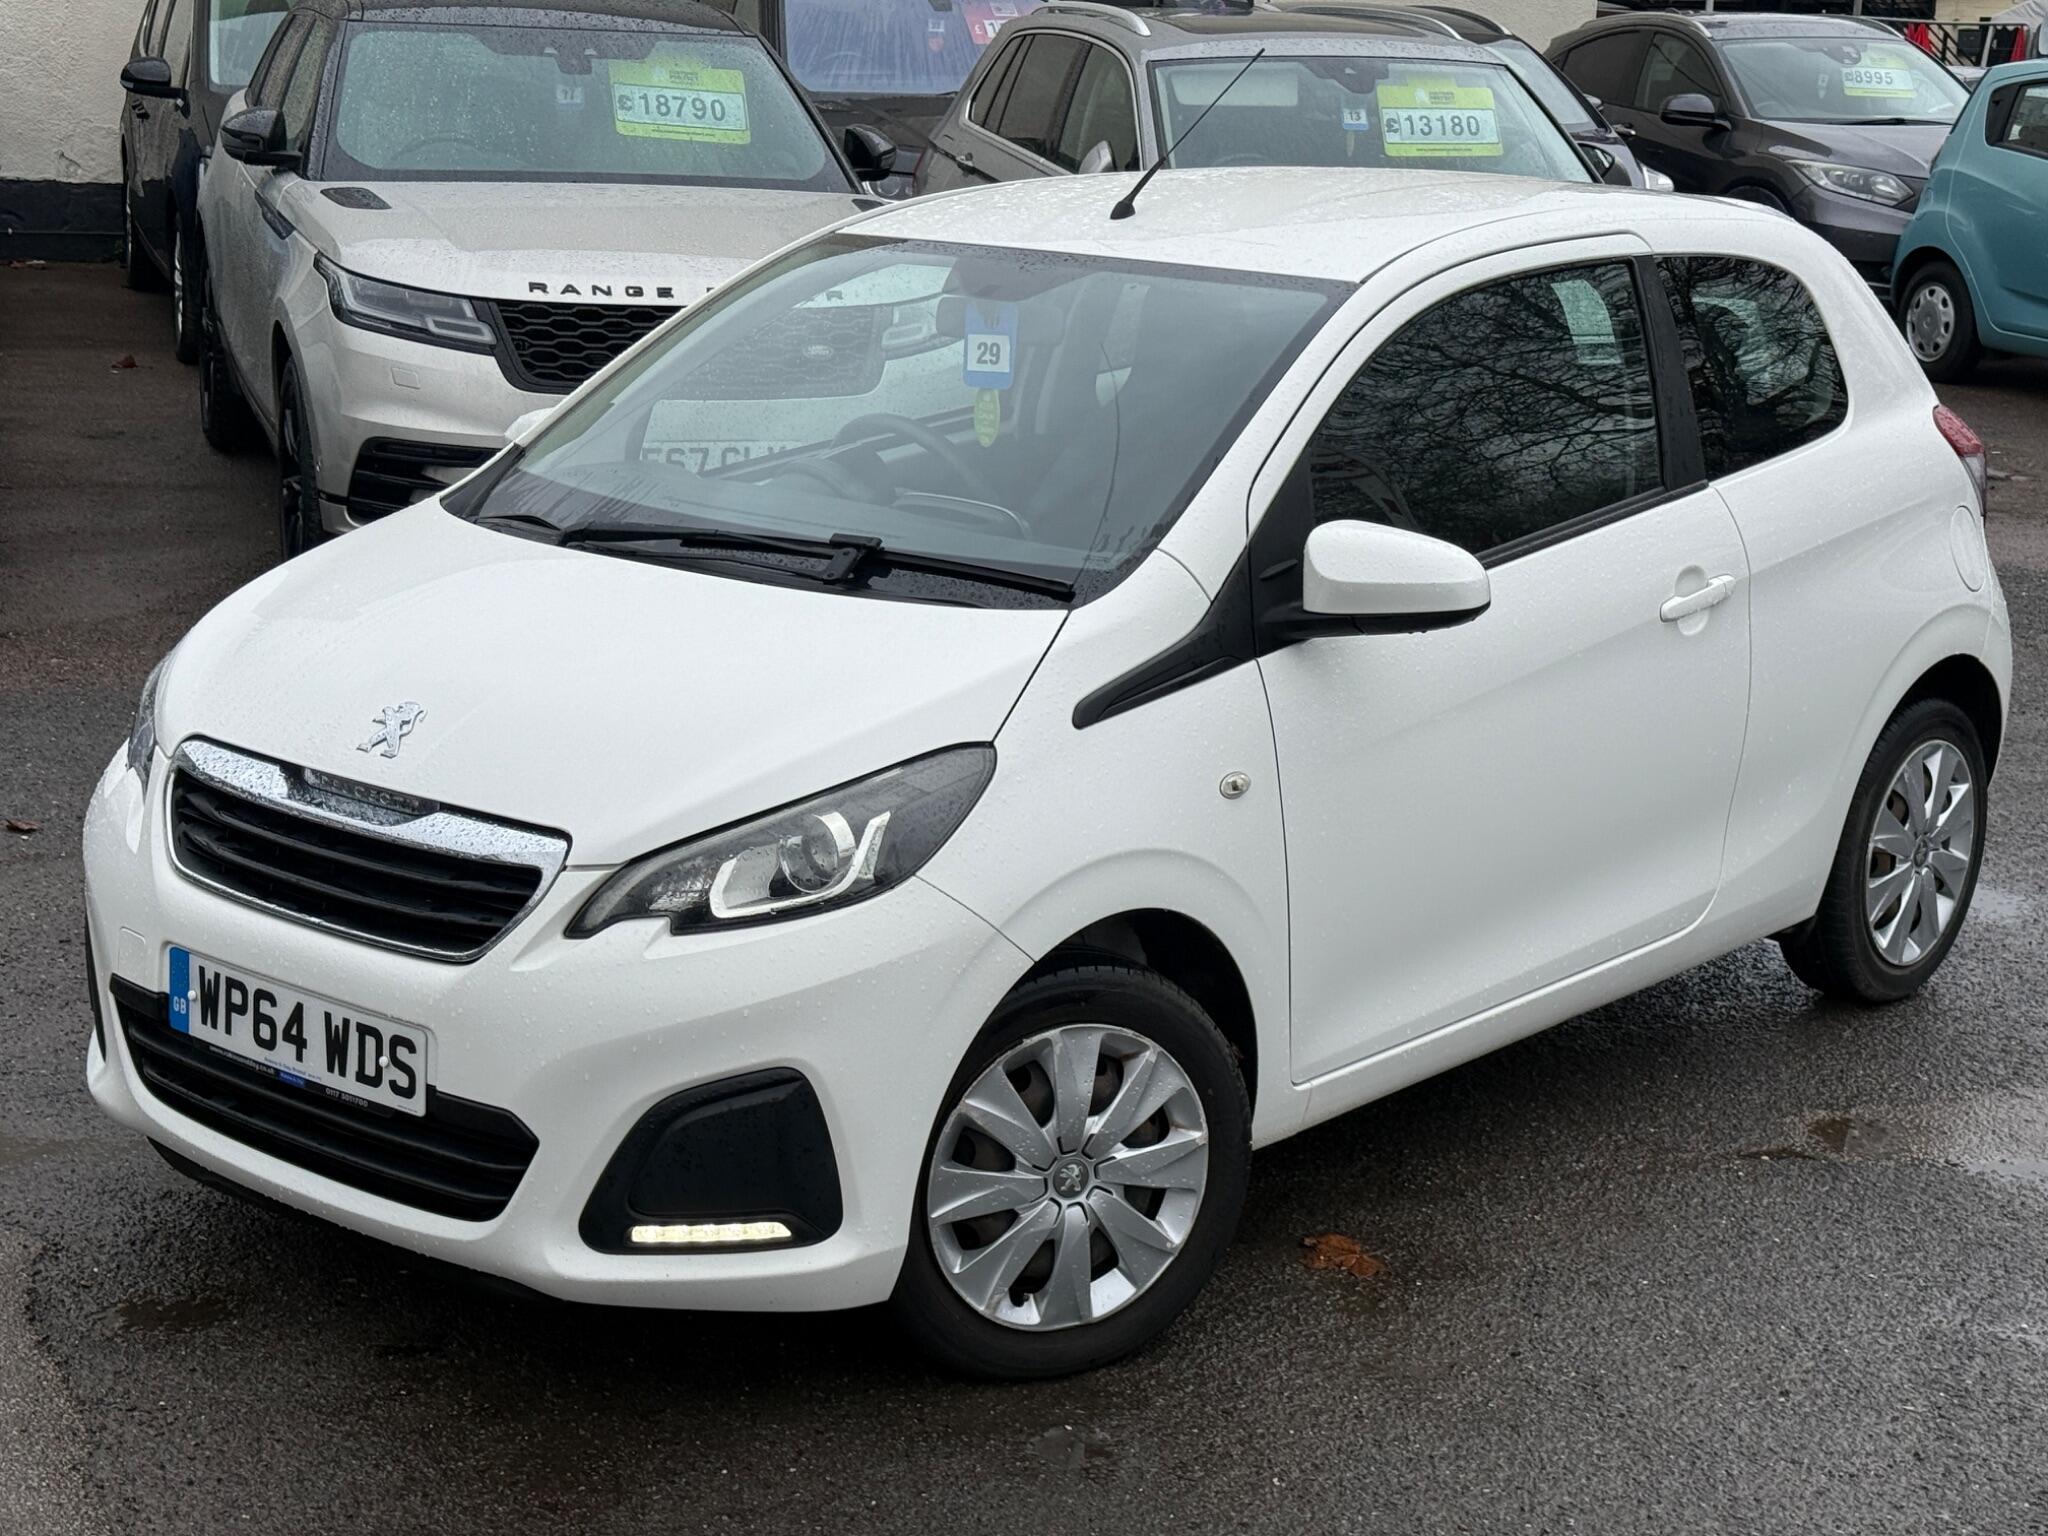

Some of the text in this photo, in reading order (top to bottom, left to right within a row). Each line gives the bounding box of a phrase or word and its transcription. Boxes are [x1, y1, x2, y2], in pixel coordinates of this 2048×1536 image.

[528, 281, 675, 299] RANGE
[976, 342, 1001, 366] 29
[172, 996, 187, 1014] GB
[197, 965, 418, 1100] WP64 WDS
